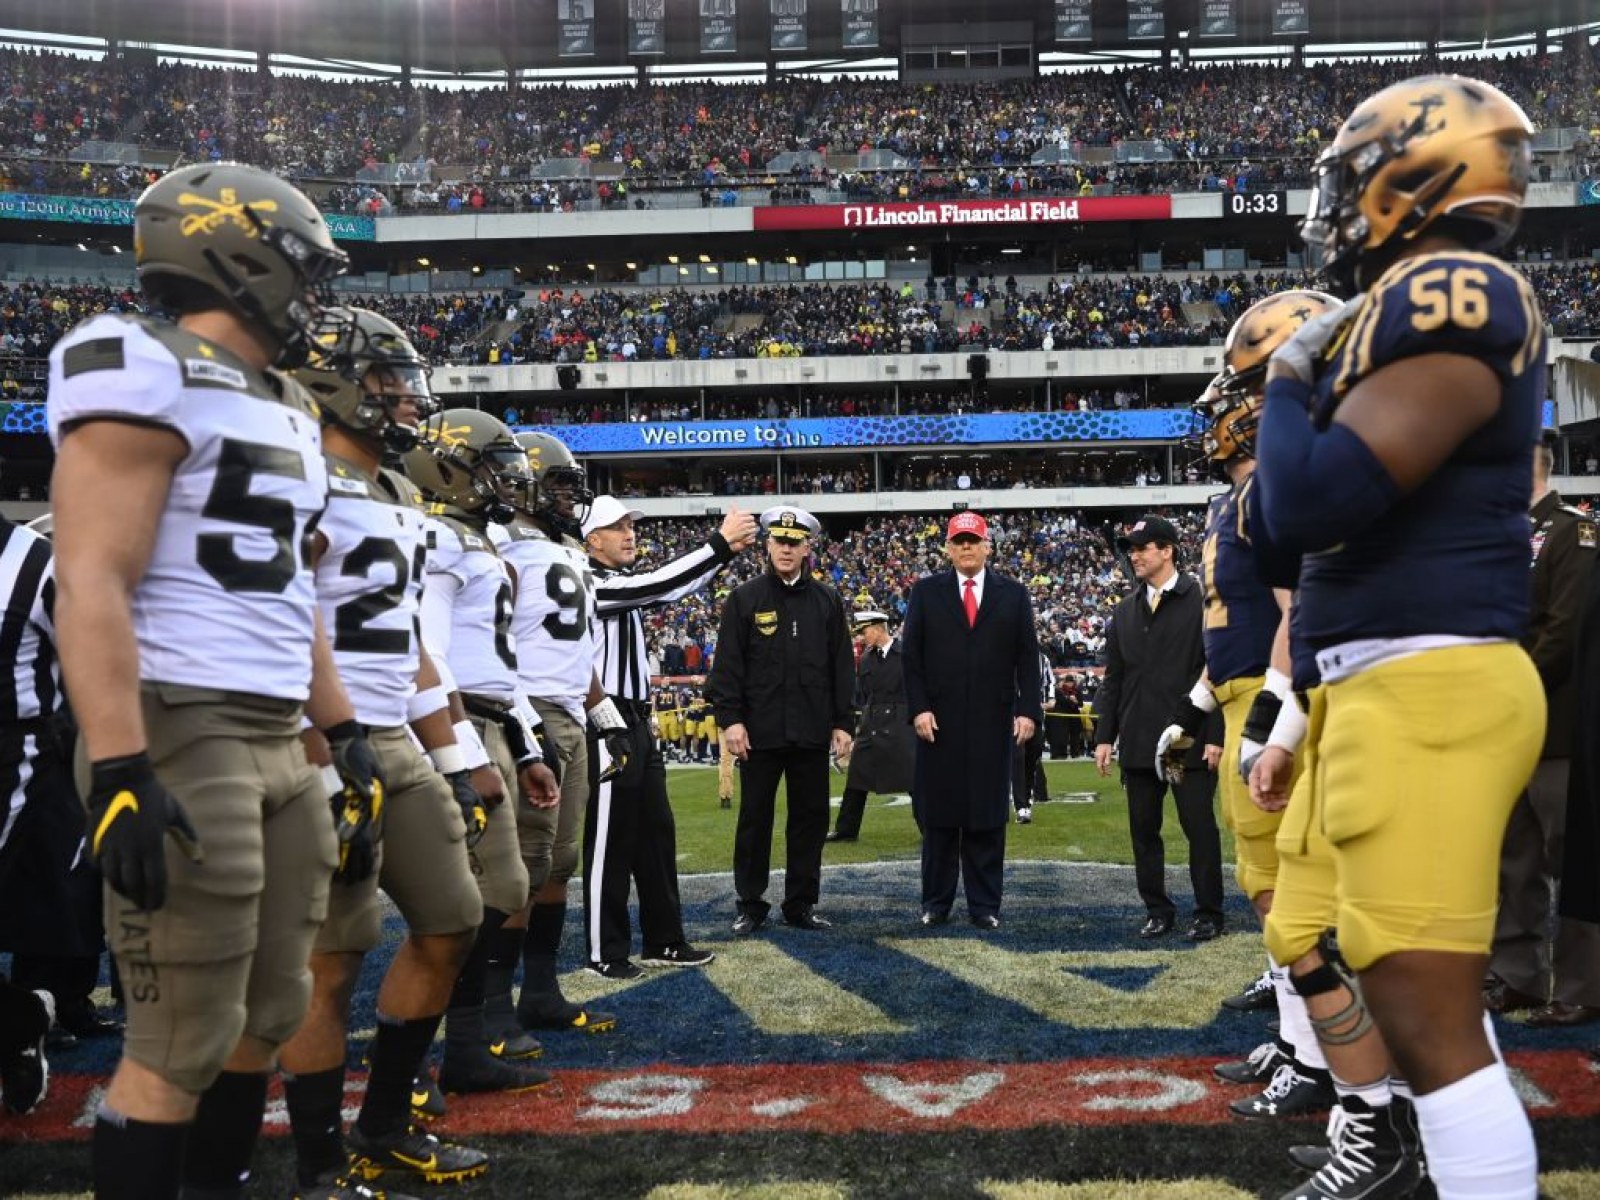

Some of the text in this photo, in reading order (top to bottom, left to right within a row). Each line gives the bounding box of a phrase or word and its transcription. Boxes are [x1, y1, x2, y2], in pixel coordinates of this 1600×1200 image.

[21, 201, 64, 214] 120th
[865, 200, 1079, 226] Lincoln Financial Field
[1232, 193, 1278, 214] 0:33
[1409, 267, 1489, 332] 56
[640, 426, 746, 445] Welcome
[755, 425, 777, 441] to
[196, 437, 313, 594] 5
[119, 906, 160, 1003] TATES
